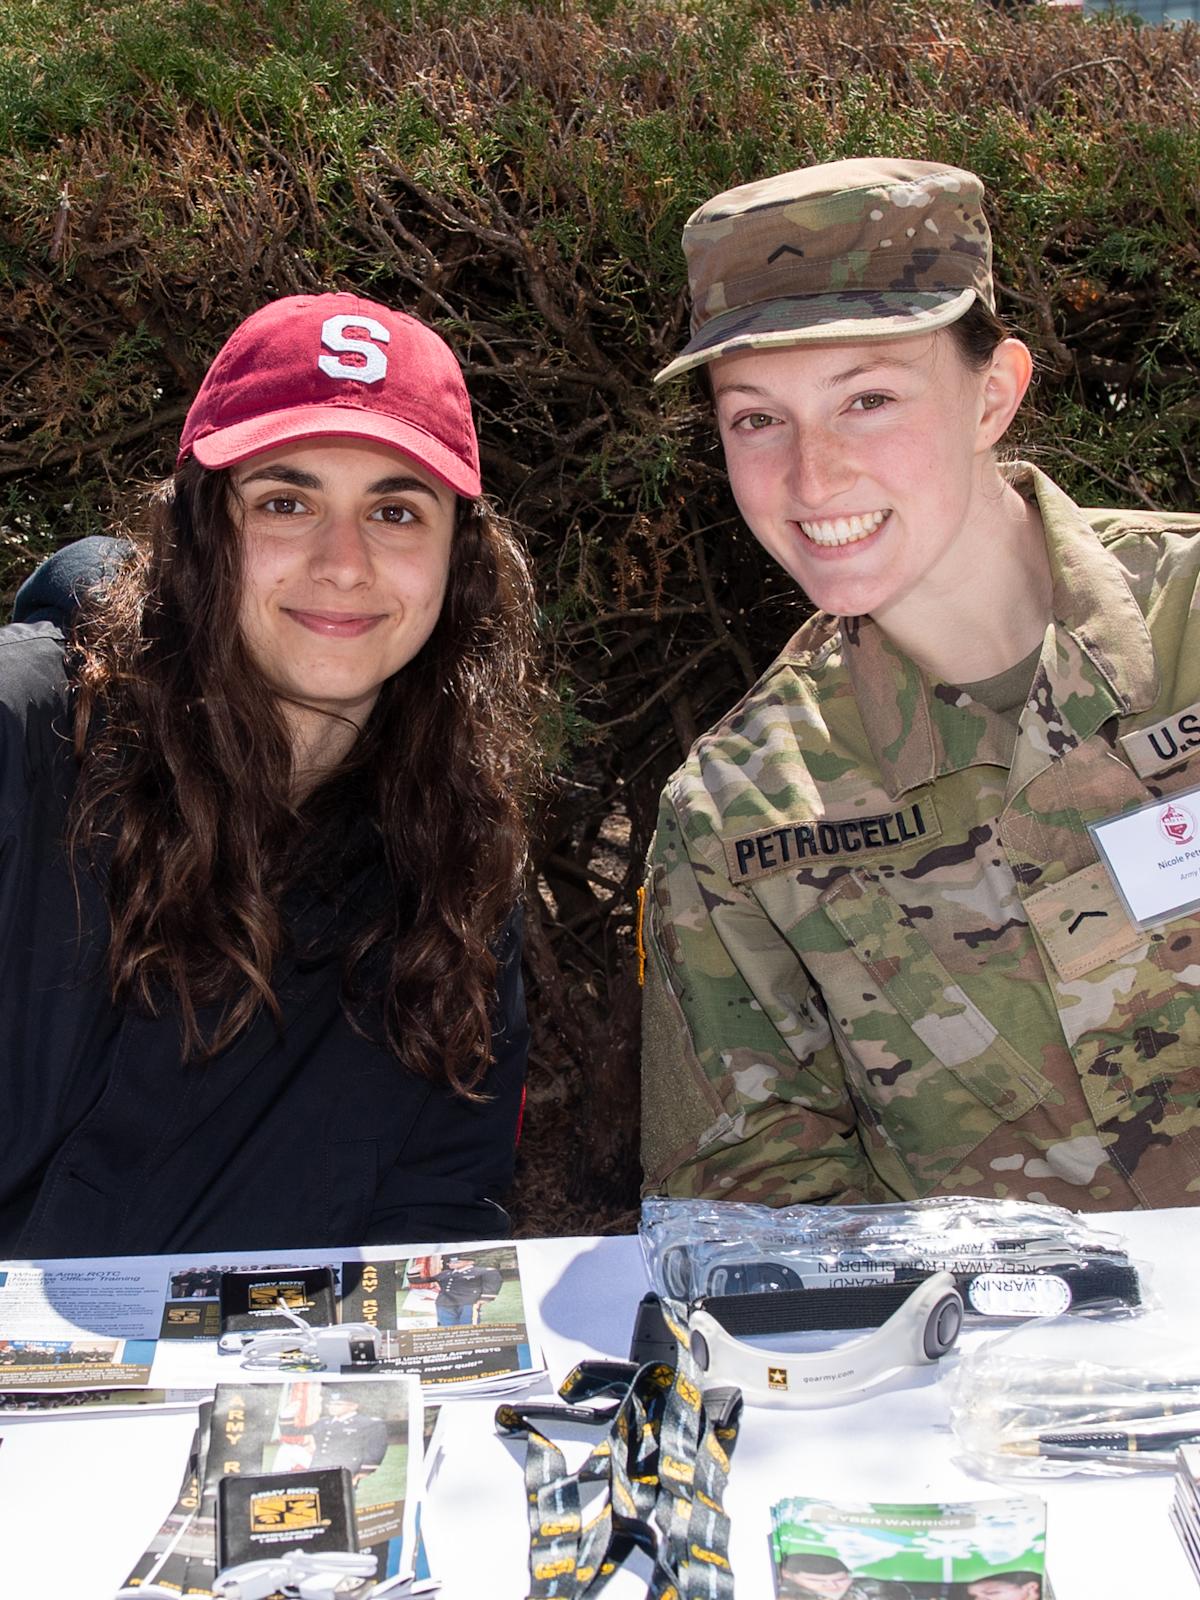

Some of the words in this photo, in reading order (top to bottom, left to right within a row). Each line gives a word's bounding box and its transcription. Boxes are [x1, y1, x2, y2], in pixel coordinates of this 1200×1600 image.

[317, 314, 391, 384] S
[735, 804, 926, 875] PETROCELLI
[1157, 855, 1184, 870] Nicole
[1180, 870, 1198, 881] Army
[818, 1260, 896, 1273] CHILDREN
[953, 1260, 993, 1273] AWAY
[362, 1265, 378, 1293] ARMY
[964, 1280, 1036, 1292] WARNING
[403, 1353, 447, 1363] University
[438, 1374, 478, 1383] Training
[481, 1369, 512, 1378] Corps
[802, 1369, 855, 1384] goarmy.com
[225, 1395, 245, 1446] ARMY
[250, 1489, 285, 1499] ARMY
[827, 1513, 881, 1526] CYBER
[884, 1517, 962, 1529] WARRIOR
